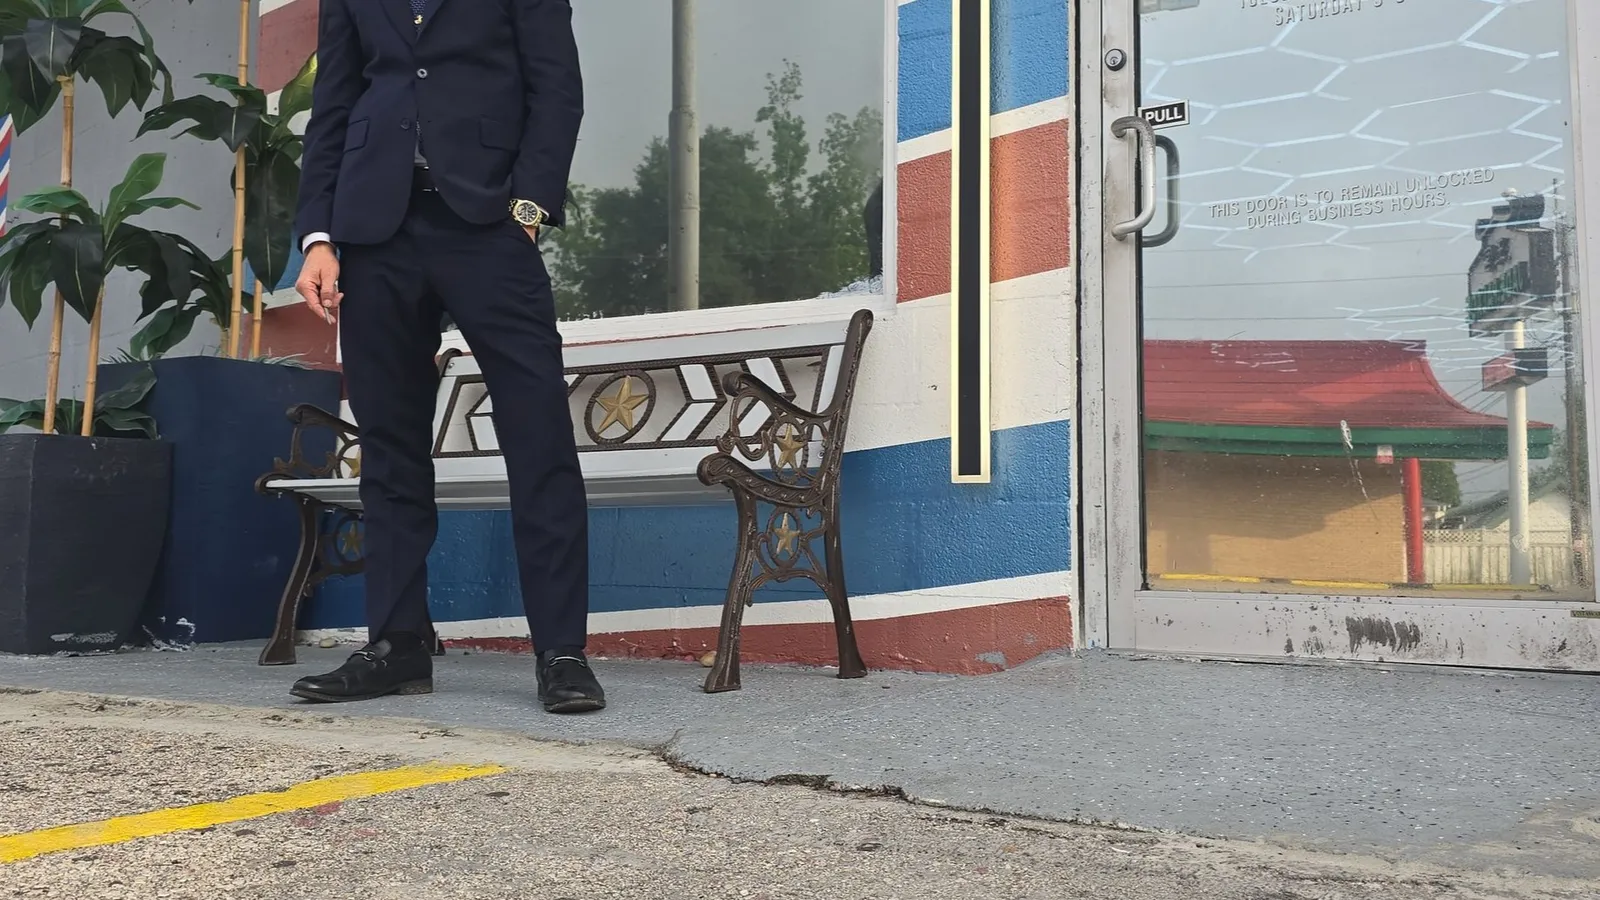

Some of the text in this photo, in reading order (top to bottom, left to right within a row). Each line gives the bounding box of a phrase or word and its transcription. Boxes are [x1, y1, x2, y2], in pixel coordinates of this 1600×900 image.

[1145, 106, 1182, 123] PULL
[1209, 167, 1495, 219] THIS DOOR IS TO REMAIN UNLOCKED
[1247, 192, 1451, 230] DURING BUSINESS HOURS.
